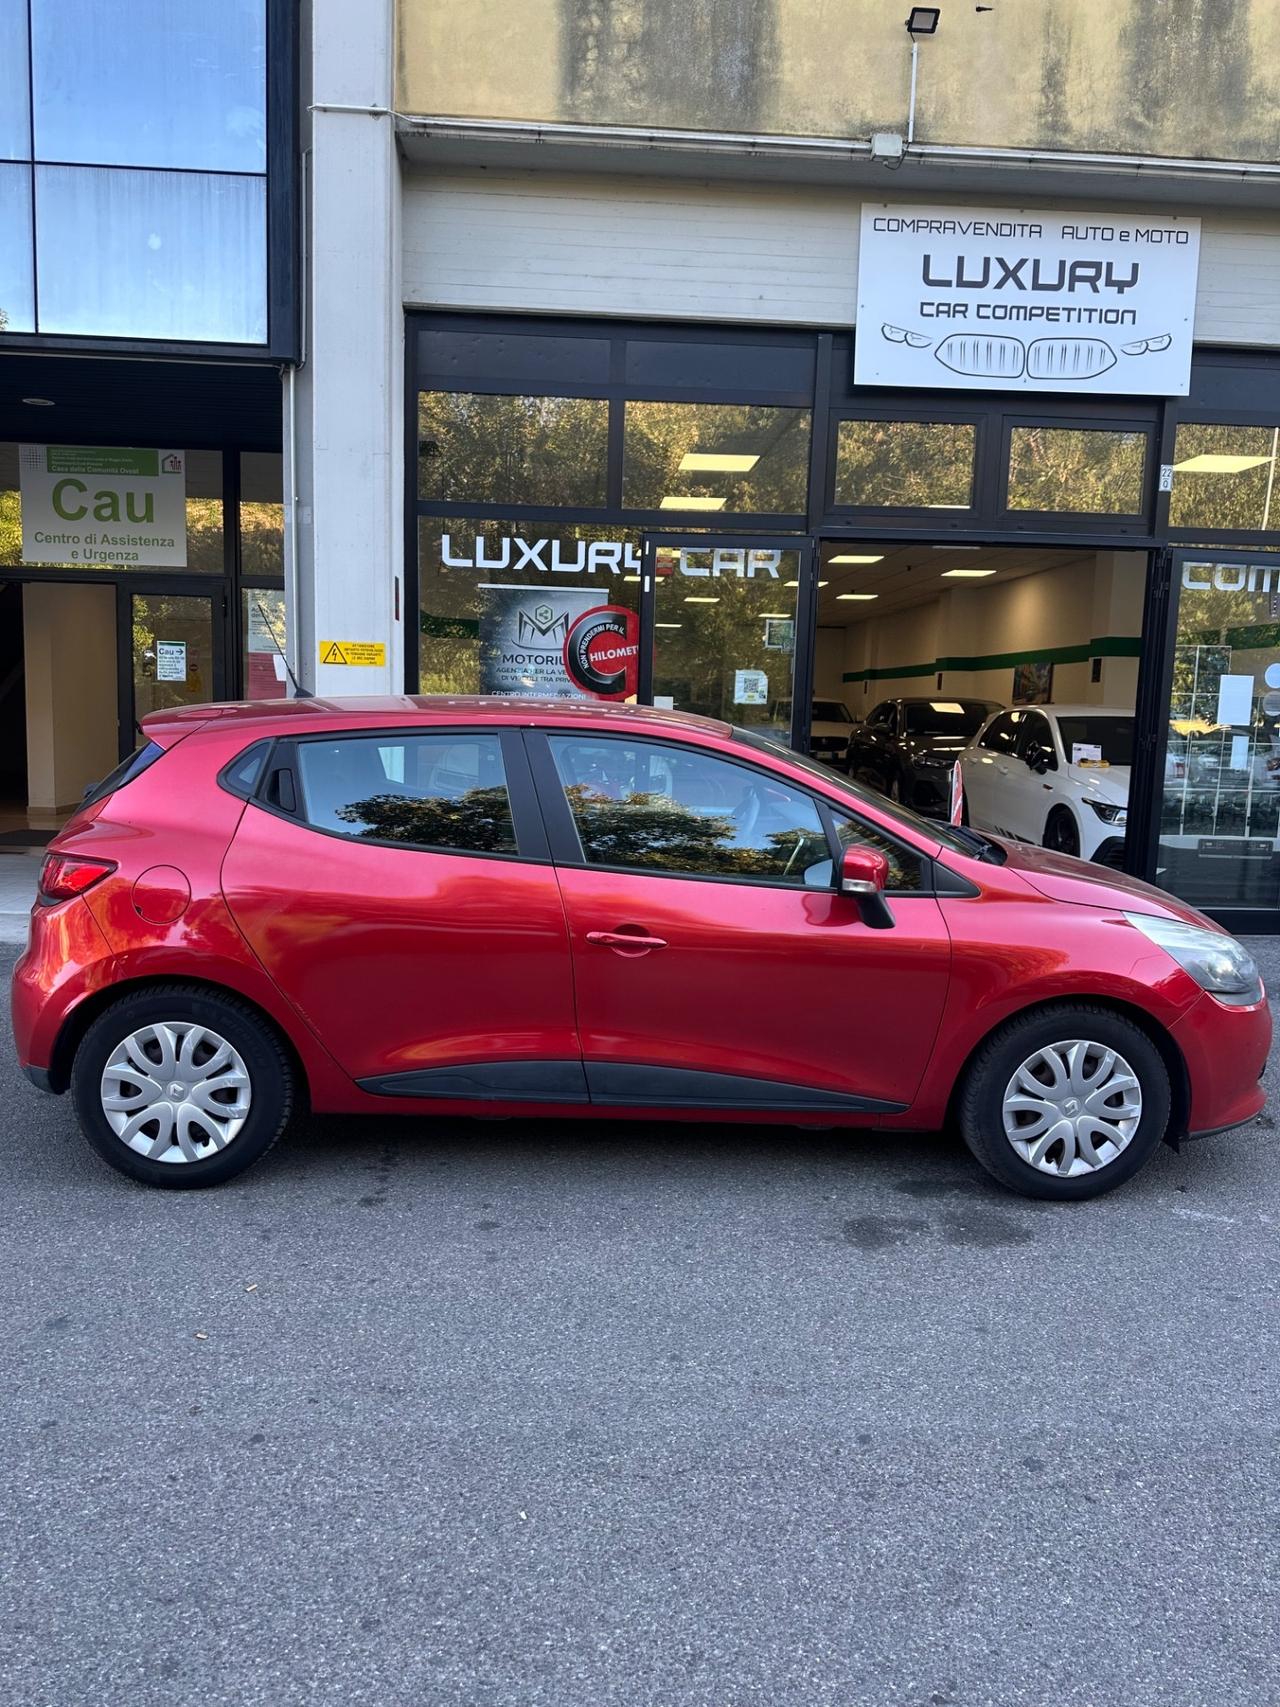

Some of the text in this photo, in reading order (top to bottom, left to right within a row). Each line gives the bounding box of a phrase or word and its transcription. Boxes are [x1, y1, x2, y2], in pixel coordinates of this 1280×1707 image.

[873, 217, 1189, 245] COMPRAVENDITA AUTO e MOTO
[922, 254, 1139, 294] LUXURY
[920, 301, 1137, 325] CAR COMPETITION
[1162, 468, 1172, 478] 22
[52, 478, 154, 523] Cau
[34, 531, 175, 548] Centro di Assistenza
[71, 548, 139, 562] e Urgenza
[679, 547, 781, 579] CAR
[580, 624, 605, 654] PRENDERMI
[605, 623, 619, 632] PER
[590, 645, 639, 662] HILOMET
